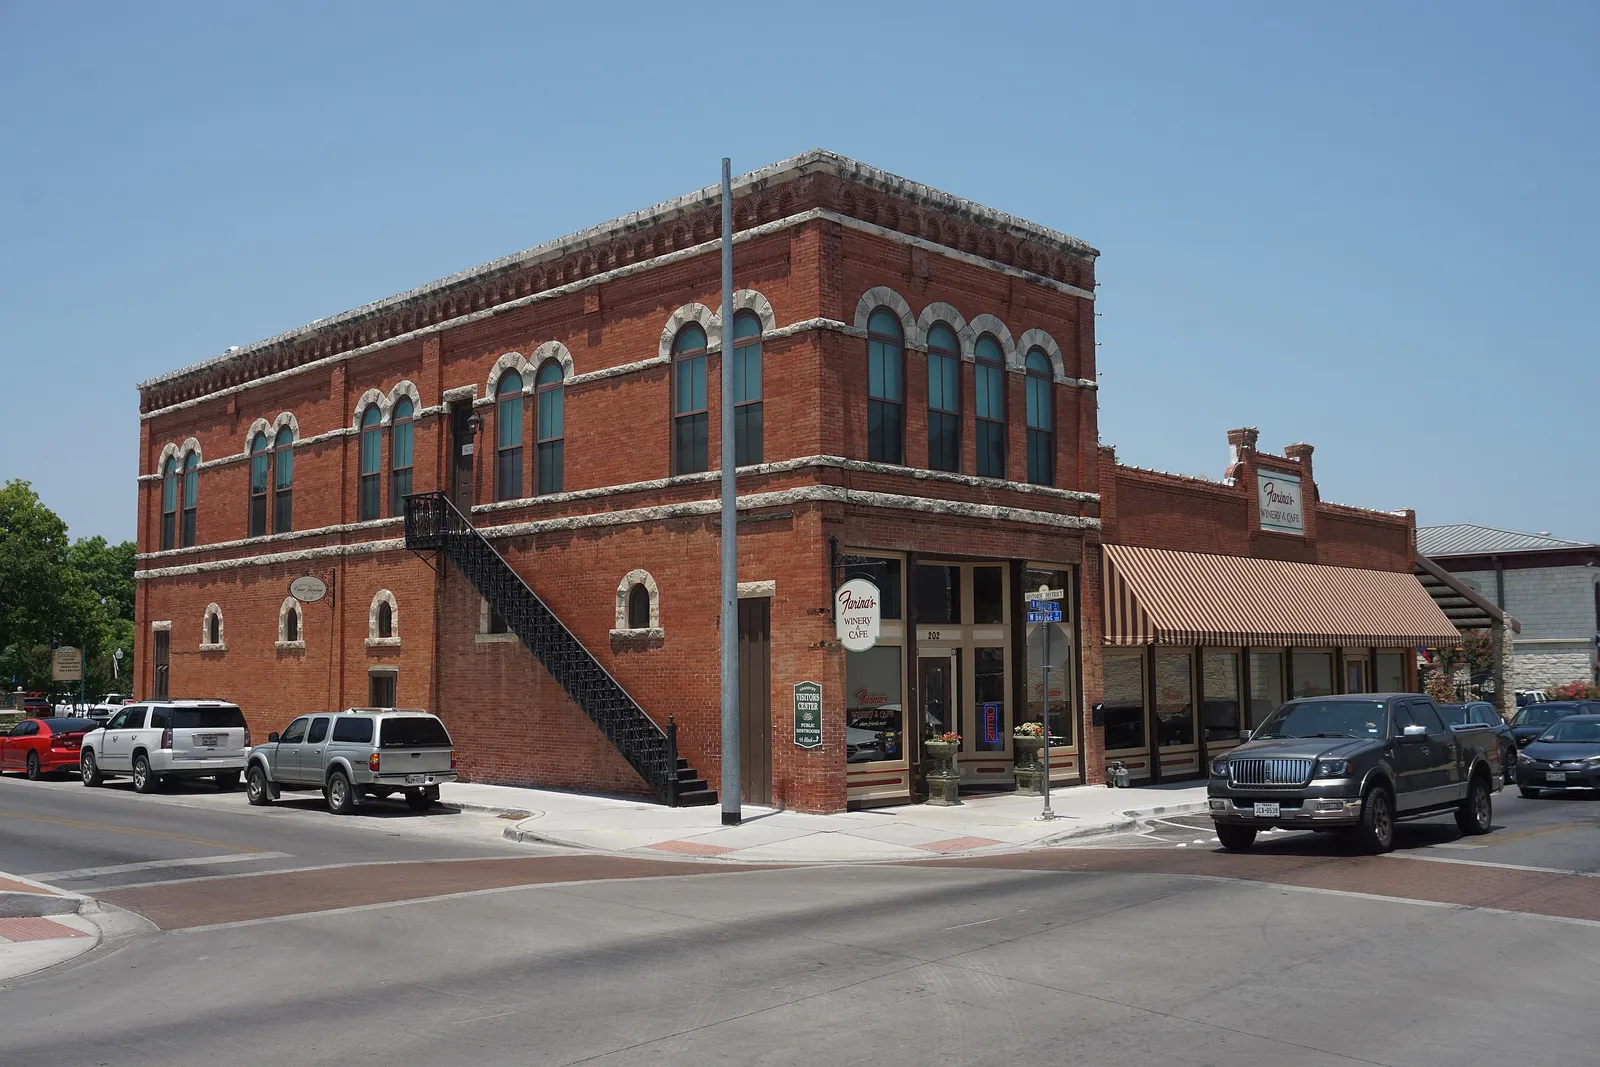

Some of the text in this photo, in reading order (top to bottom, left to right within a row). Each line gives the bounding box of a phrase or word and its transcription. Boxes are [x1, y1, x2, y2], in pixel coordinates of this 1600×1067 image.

[1264, 482, 1294, 507] Farina's
[1260, 509, 1300, 524] WINERY & CAFE
[838, 590, 876, 616] Farina's
[844, 616, 872, 626] WINERY
[848, 630, 868, 640] CAFE
[928, 632, 940, 640] 202
[798, 702, 818, 710] CENTER
[986, 706, 996, 740] OPEN
